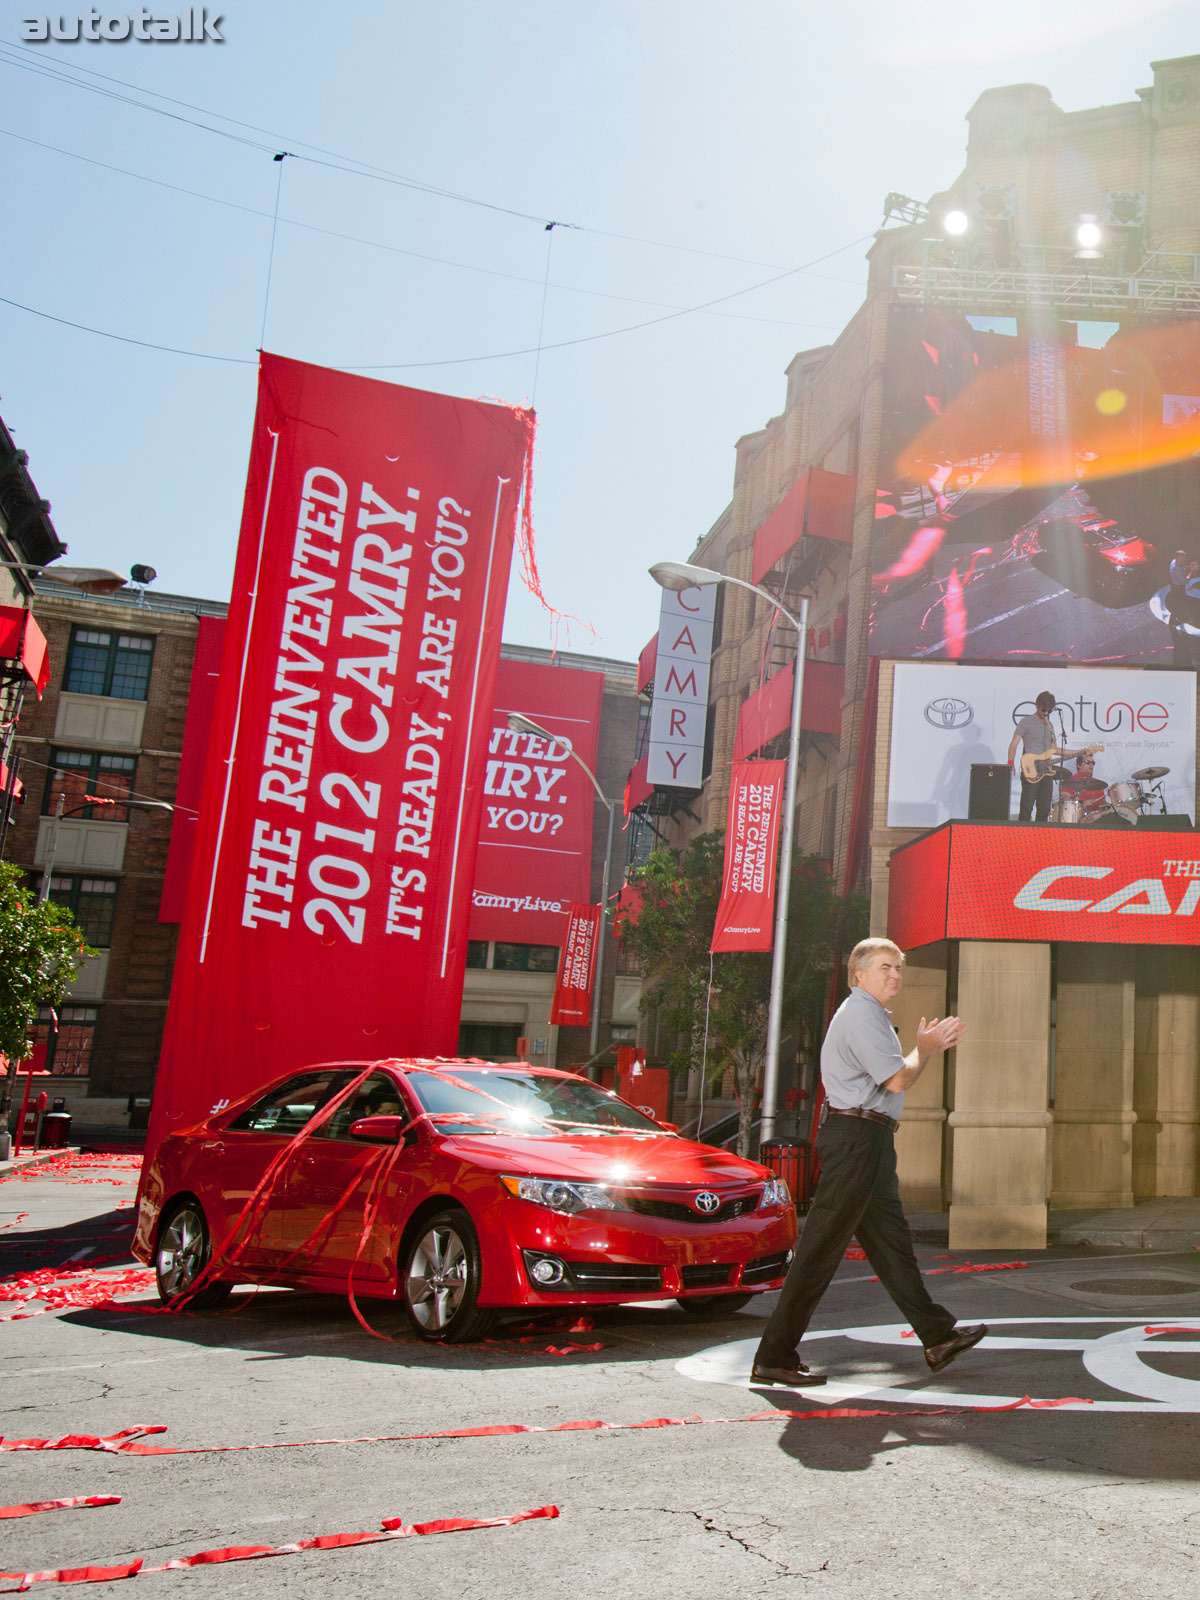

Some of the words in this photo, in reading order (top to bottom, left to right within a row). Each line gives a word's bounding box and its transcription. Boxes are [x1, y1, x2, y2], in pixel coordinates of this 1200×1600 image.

[428, 496, 472, 602] YOU?
[259, 466, 348, 814] REINVENTED
[329, 483, 420, 753] CAMRY.
[416, 607, 458, 698] ARE
[664, 586, 702, 779] CAMRY
[1106, 738, 1122, 748] with
[1124, 741, 1141, 750] your
[396, 711, 449, 859] READY,
[738, 786, 747, 802] IT'S
[748, 784, 762, 823] 2012
[763, 785, 774, 809] THE
[487, 807, 563, 835] YOU?
[734, 843, 743, 864] ARE
[736, 804, 746, 840] READY,
[753, 812, 770, 893] REINVENTED
[242, 819, 301, 929] THE
[304, 773, 381, 944] 2012
[731, 866, 740, 893] YOU?
[739, 827, 759, 893] CAMRY.
[386, 866, 428, 940] IT'S
[577, 918, 588, 944] 2012
[570, 946, 584, 989] CAMRY.
